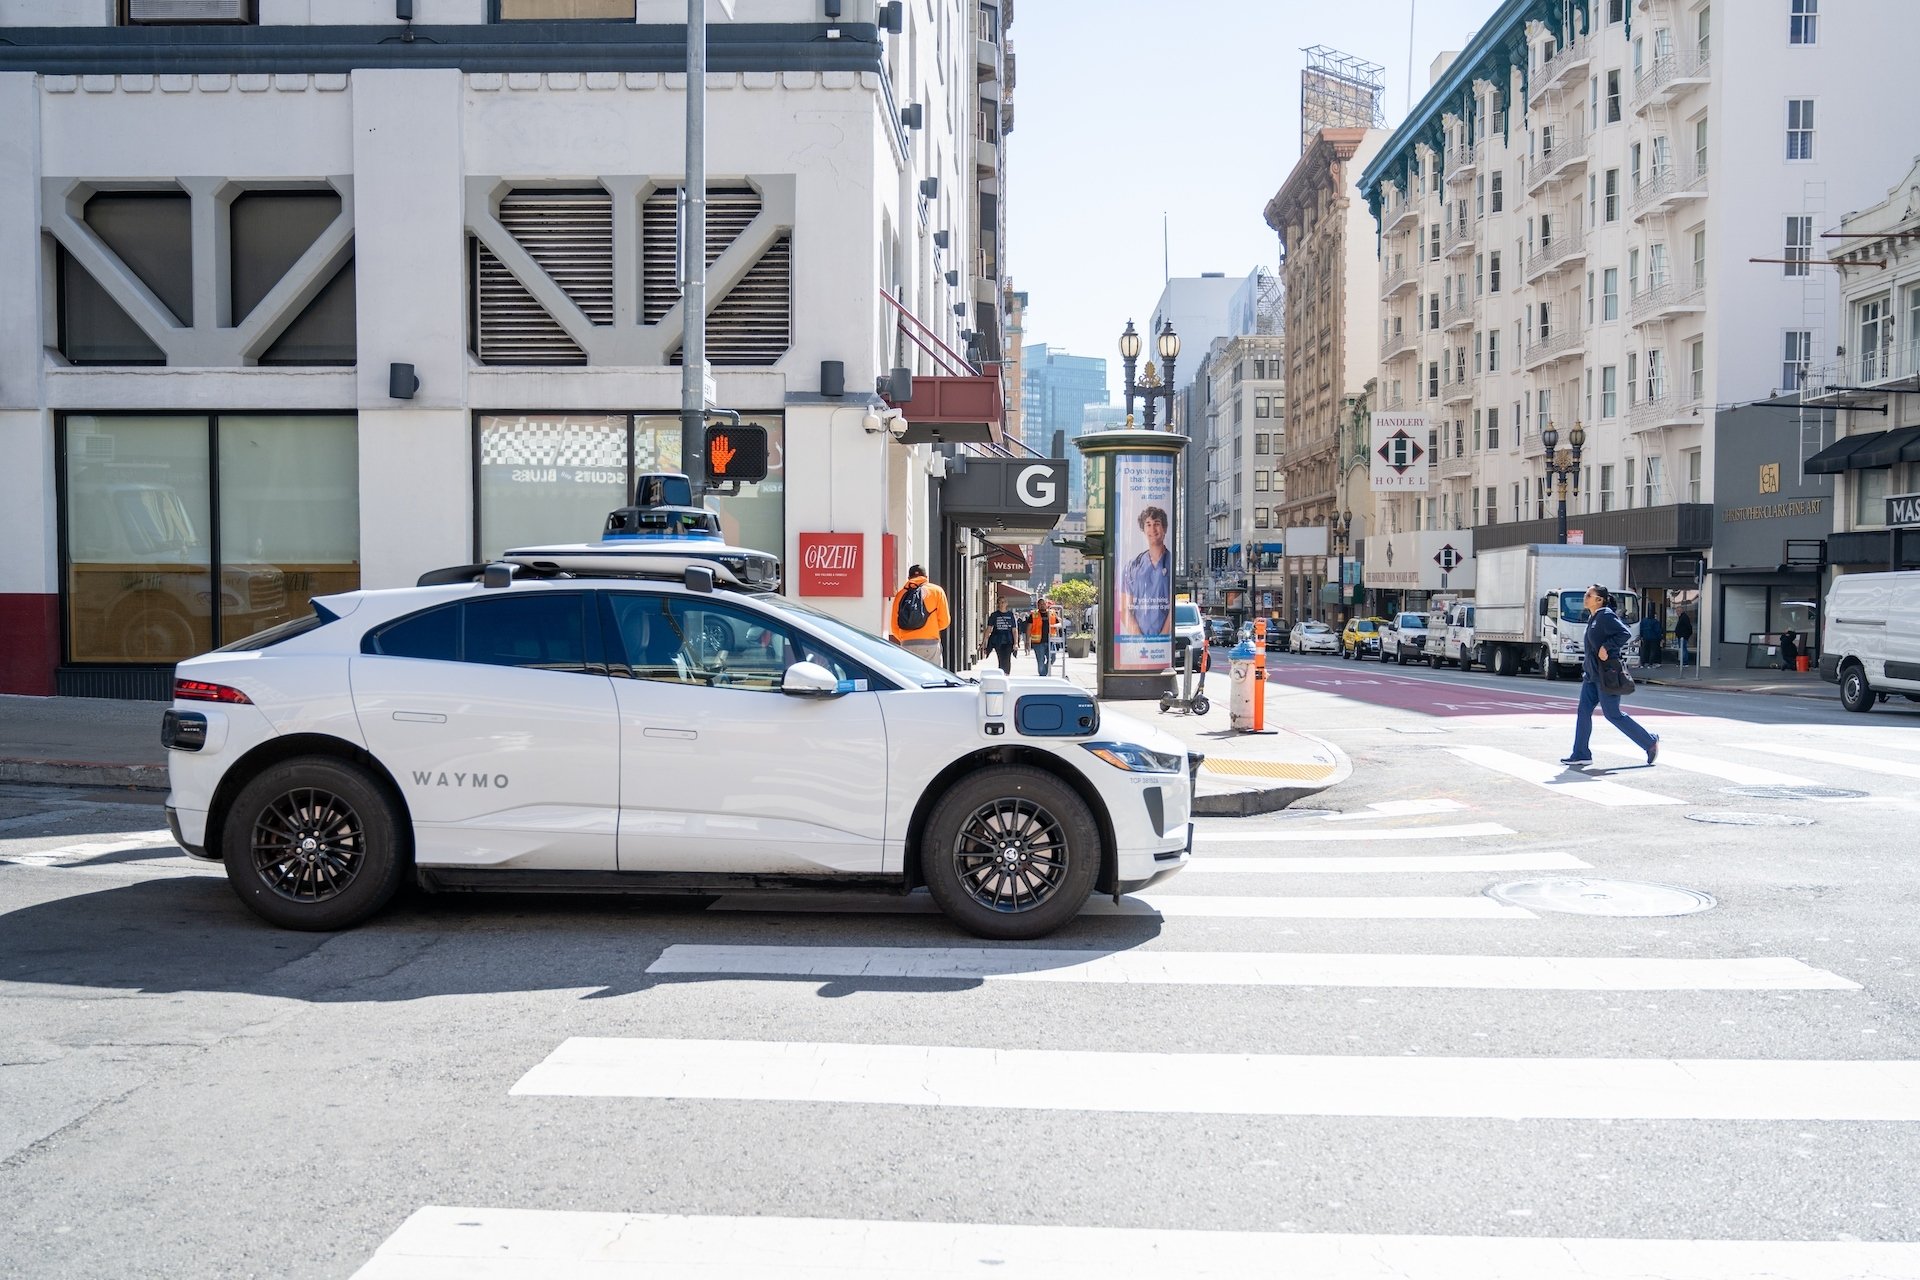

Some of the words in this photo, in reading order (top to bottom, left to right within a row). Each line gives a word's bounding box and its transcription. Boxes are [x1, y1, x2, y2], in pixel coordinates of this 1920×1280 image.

[1377, 418, 1424, 426] HANDLERY
[1016, 464, 1056, 507] G
[1375, 477, 1425, 485] HOTEL
[1788, 501, 1805, 516] FINE
[1805, 499, 1822, 514] ART
[994, 562, 1024, 570] WESTIN
[412, 771, 508, 788] WAYMO
